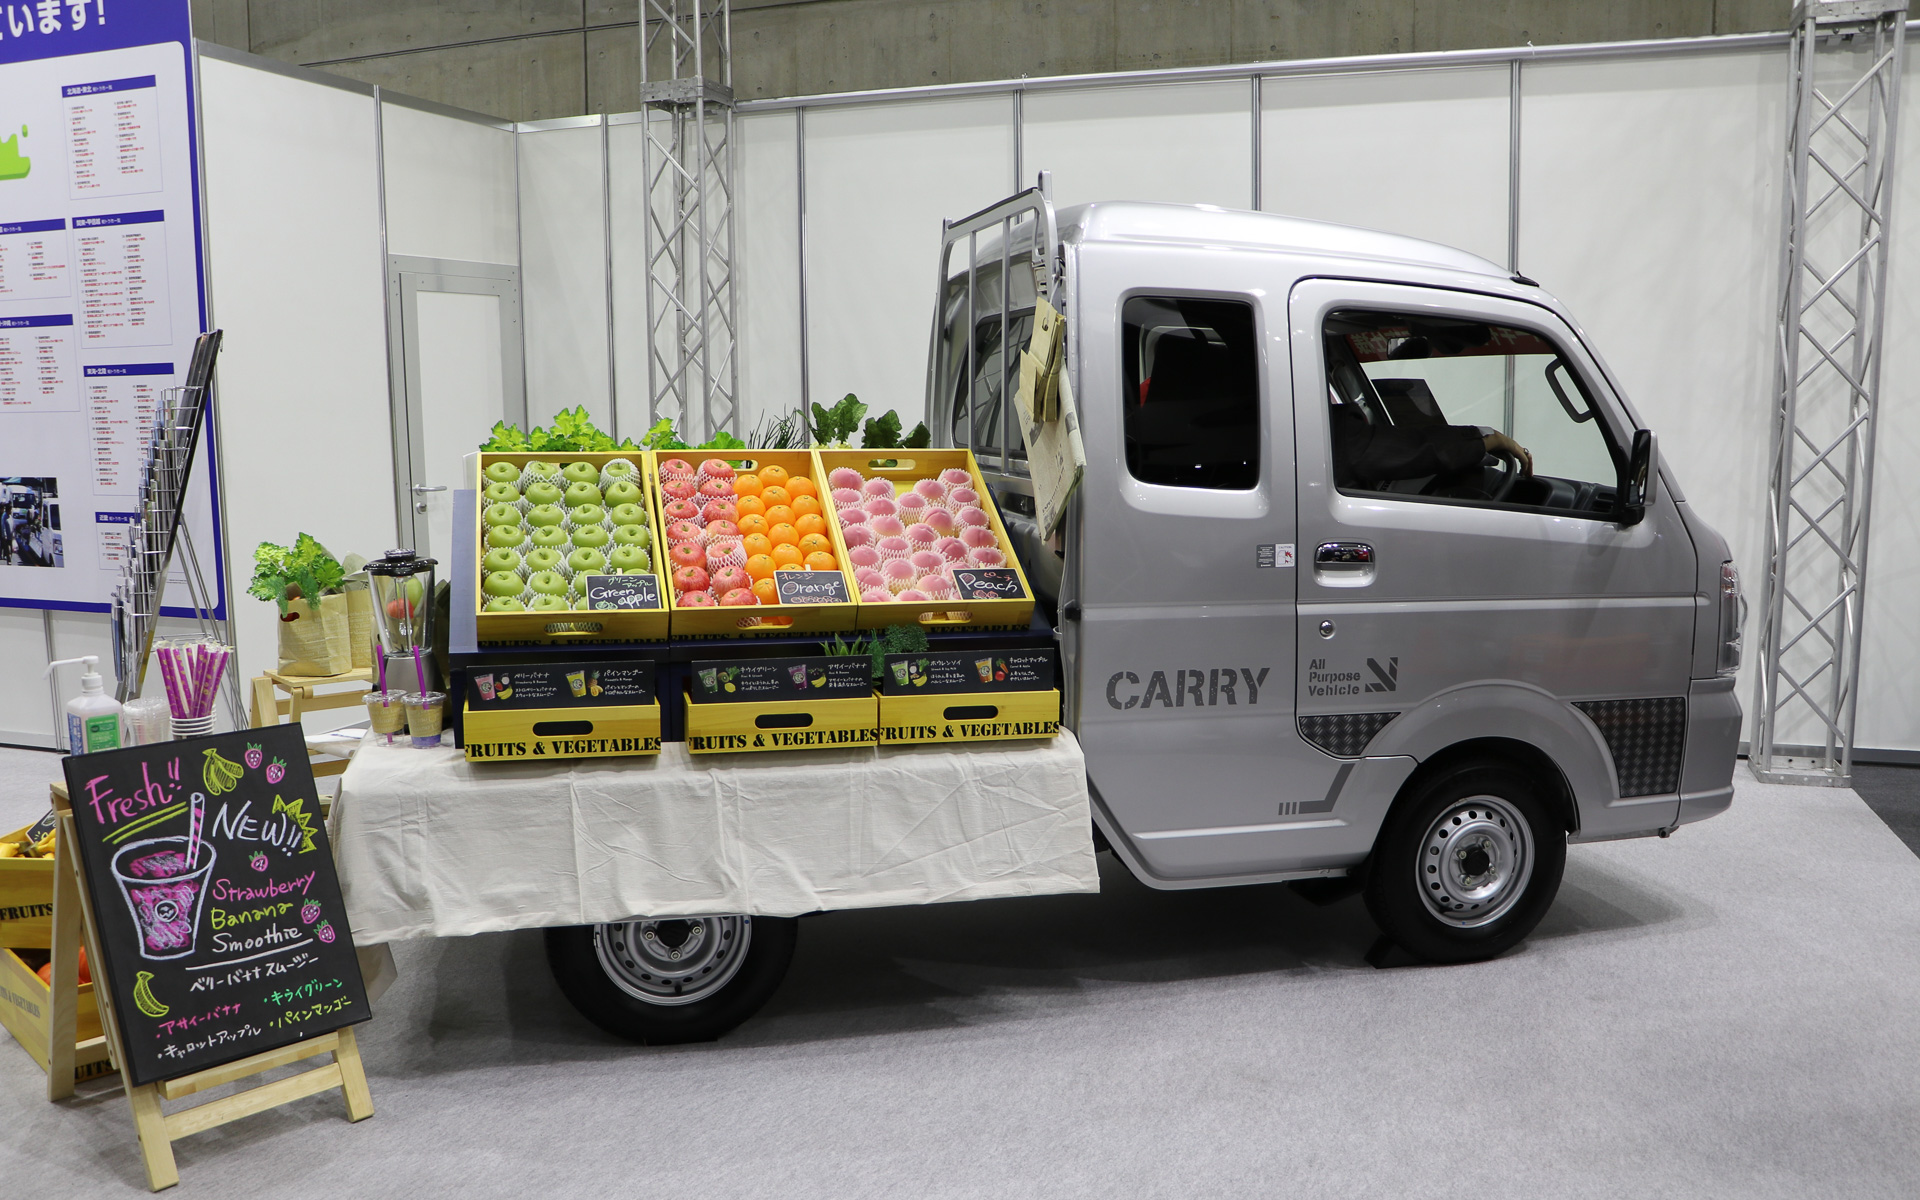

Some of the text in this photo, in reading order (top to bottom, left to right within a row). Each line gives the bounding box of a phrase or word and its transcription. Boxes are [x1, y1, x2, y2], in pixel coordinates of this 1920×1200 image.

[0, 0, 106, 40] います!
[608, 576, 638, 586] グリーン
[622, 579, 654, 588] アップル
[779, 572, 815, 581] オレンジ
[958, 572, 1018, 593] Peach
[983, 571, 1012, 582] ピーチ
[590, 586, 635, 600] Green
[617, 586, 657, 609] apple
[781, 580, 842, 596] Orange
[1309, 658, 1326, 670] All
[1309, 671, 1361, 684] Purpose
[1106, 667, 1270, 710] CARRY
[1308, 684, 1360, 696] Vehicle
[753, 734, 766, 748] &
[771, 728, 879, 746] VEGETABLES
[942, 725, 954, 738] &
[960, 721, 1060, 737] VEGETABLES
[532, 741, 546, 756] &
[552, 736, 661, 755] VEGETABLES
[84, 757, 182, 824] Fresh!!
[212, 800, 302, 856] NEW!!
[212, 870, 316, 901] Strawberry
[0, 903, 53, 920] FRUITS
[211, 902, 293, 930] Banana
[212, 922, 303, 953] Smoothie
[190, 952, 320, 992] ベリーバナナ スムージー
